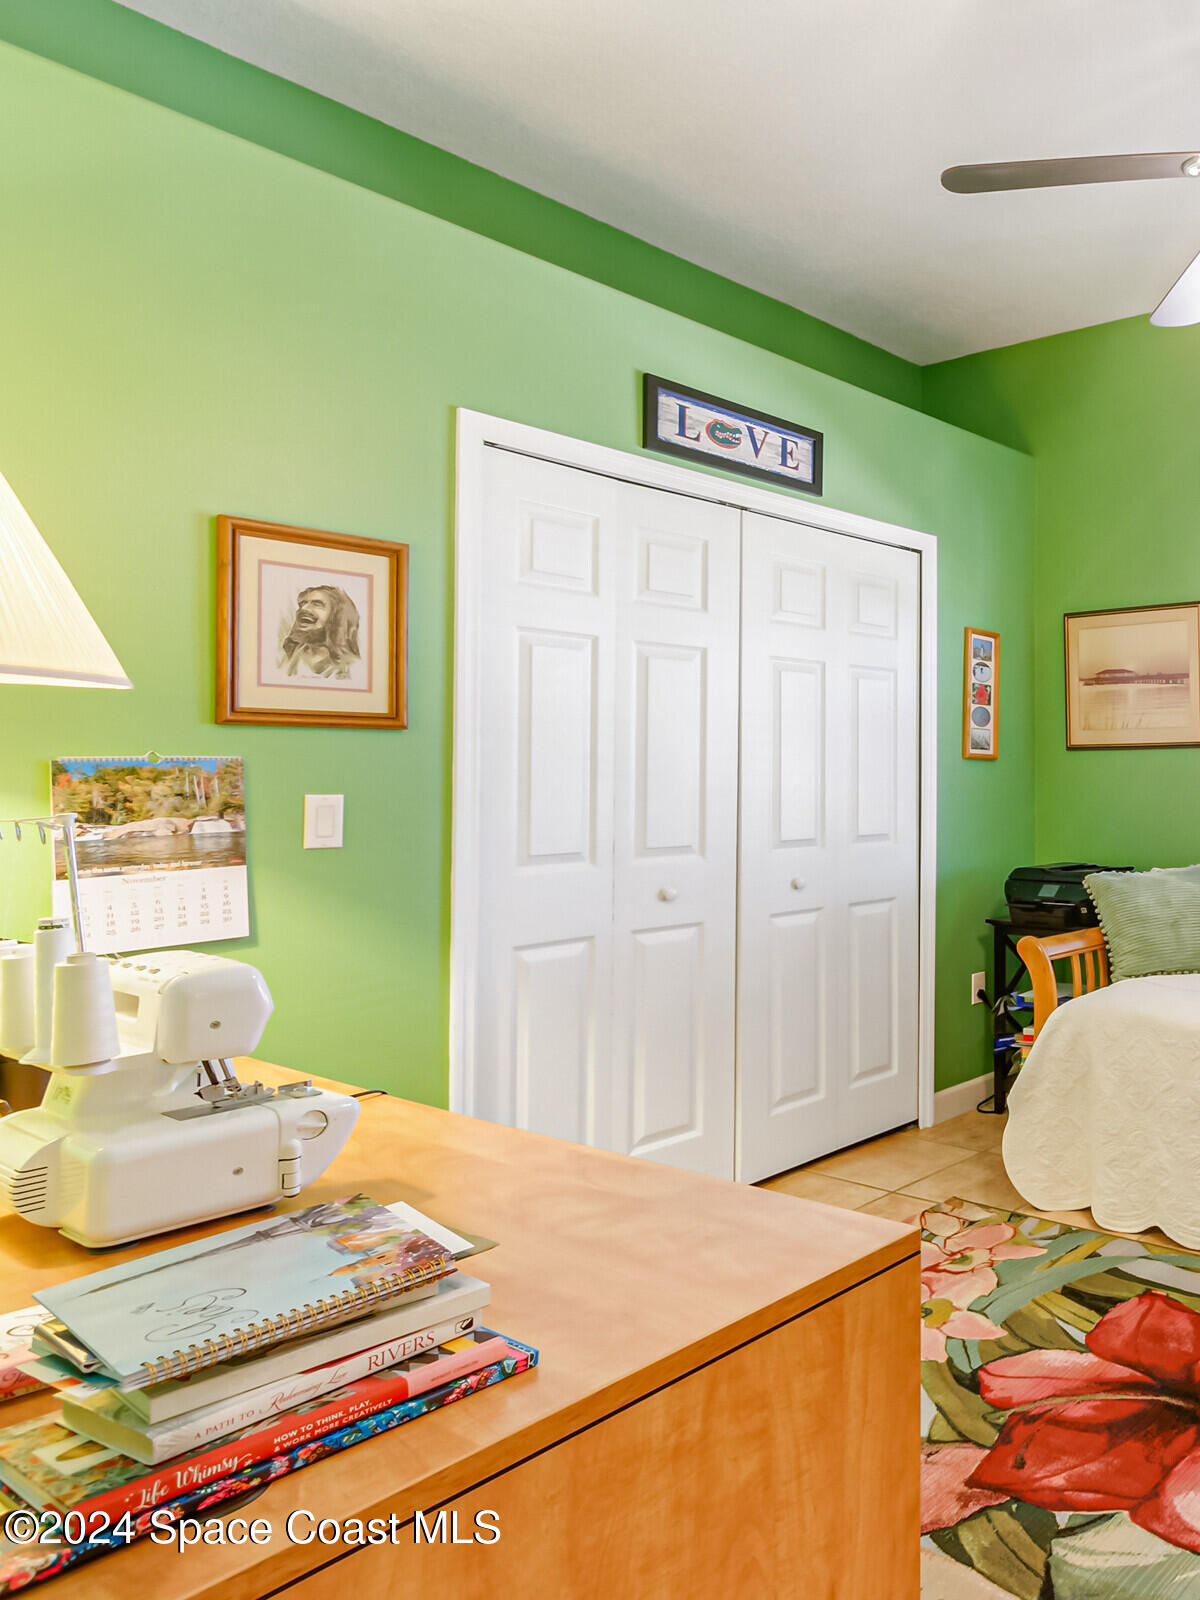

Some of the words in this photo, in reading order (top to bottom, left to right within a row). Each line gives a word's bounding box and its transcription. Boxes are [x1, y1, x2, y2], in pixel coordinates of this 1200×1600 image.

[205, 1417, 235, 1436] PATH
[239, 1410, 255, 1424] TO
[367, 1331, 435, 1371] RIVERS
[274, 1429, 299, 1444] HOW
[301, 1423, 314, 1433] TO
[283, 1433, 311, 1448] WORK
[314, 1421, 340, 1436] MORE
[342, 1398, 393, 1424] CREATIVELY
[133, 1479, 170, 1513] Life
[176, 1453, 252, 1489] Whimsy
